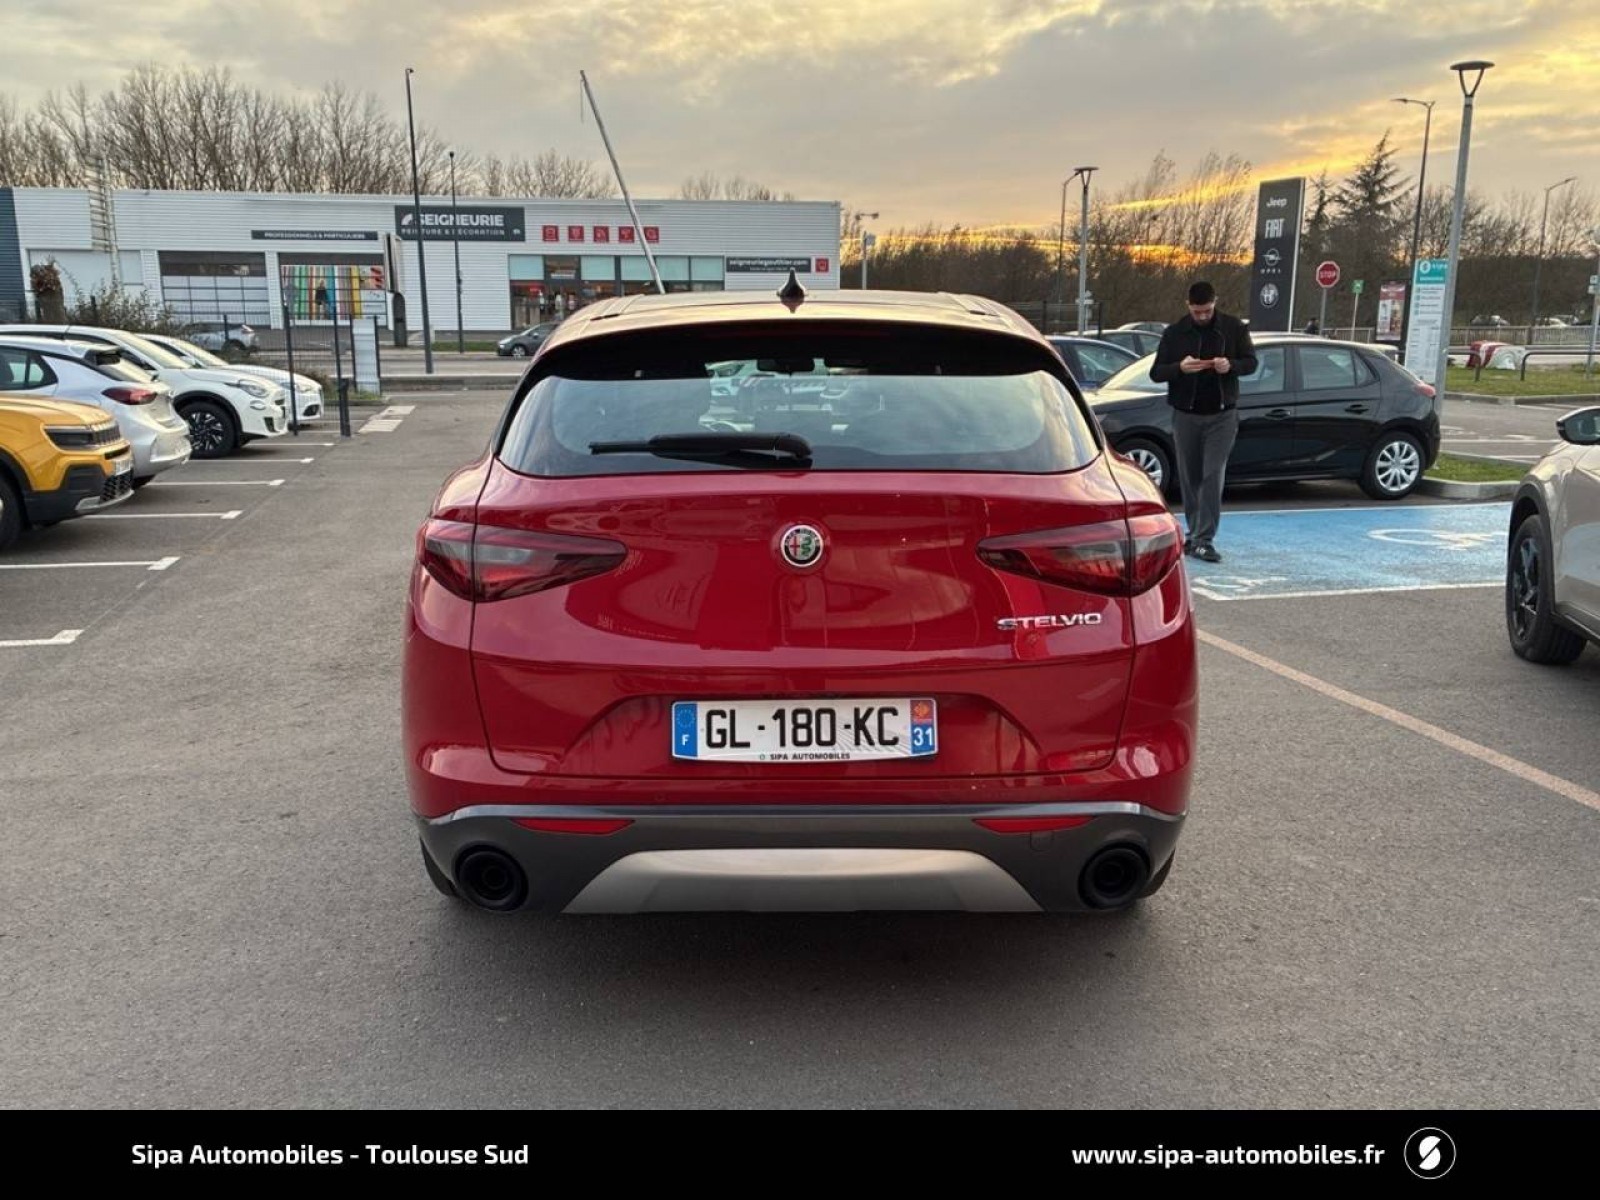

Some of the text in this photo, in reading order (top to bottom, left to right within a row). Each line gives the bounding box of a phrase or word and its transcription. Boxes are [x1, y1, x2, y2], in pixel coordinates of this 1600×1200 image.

[1266, 197, 1288, 208] Jeep
[1265, 218, 1285, 239] FIAT
[1319, 270, 1336, 279] STOP
[997, 613, 1102, 630] STELVIO
[682, 734, 690, 745] F
[913, 727, 934, 746] 31
